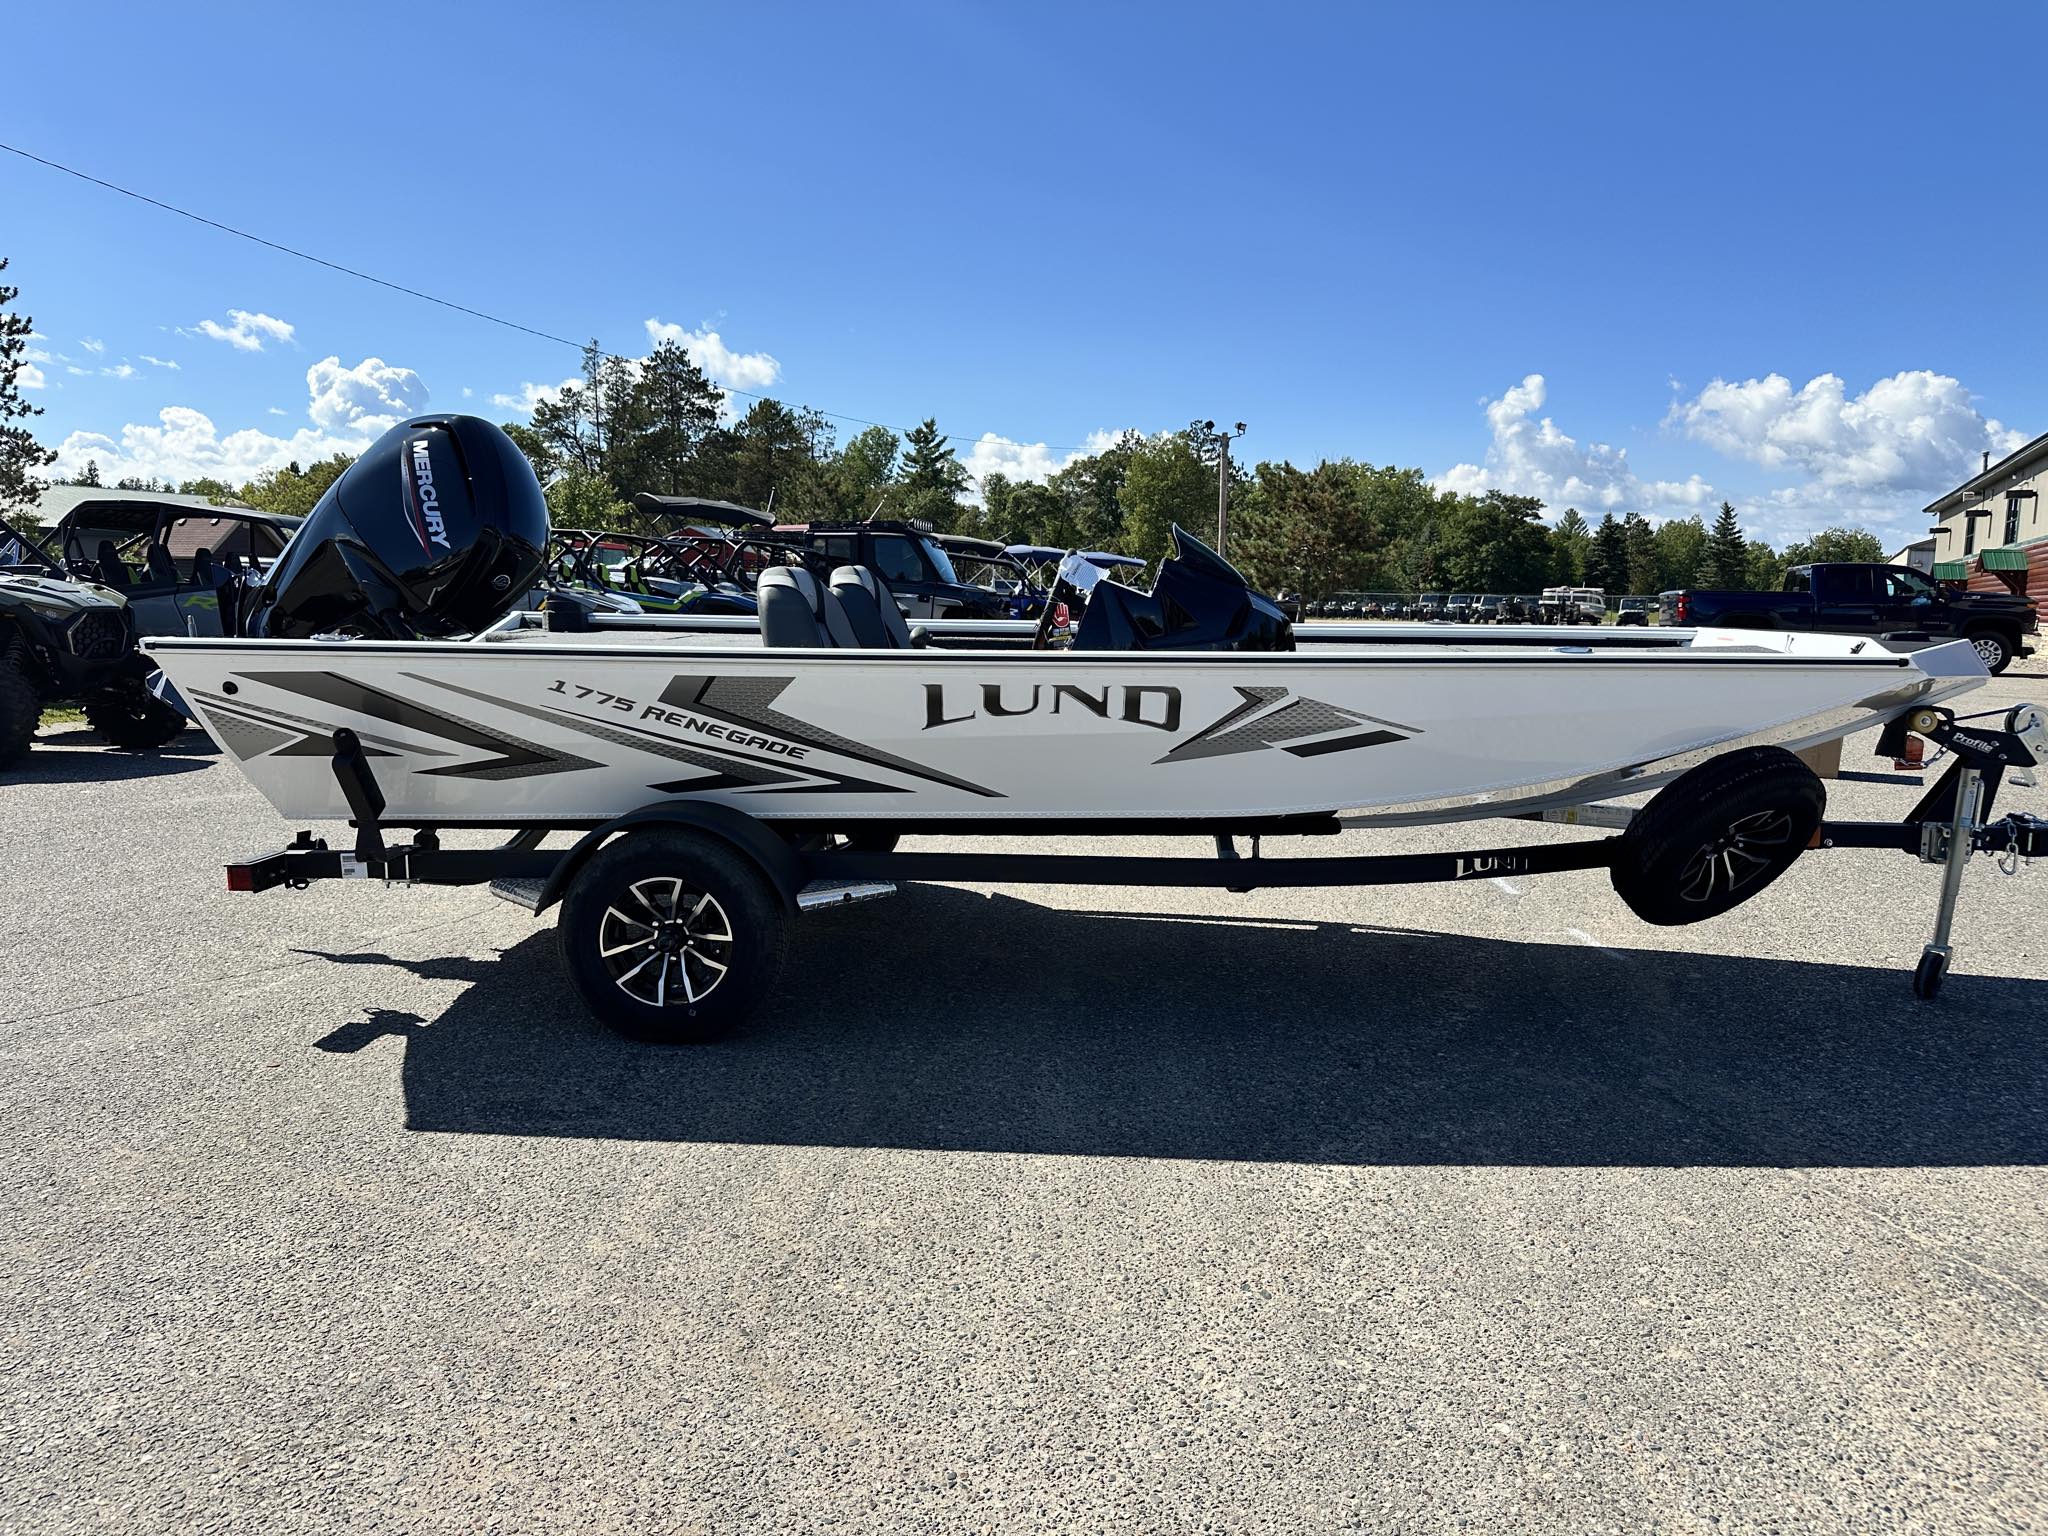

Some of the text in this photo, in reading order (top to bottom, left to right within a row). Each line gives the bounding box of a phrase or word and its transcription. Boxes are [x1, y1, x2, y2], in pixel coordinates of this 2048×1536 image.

[412, 440, 451, 549] MERCURY
[547, 679, 810, 760] 1775 RENEGADE
[921, 683, 1182, 732] LUND
[1952, 732, 1993, 751] Profile
